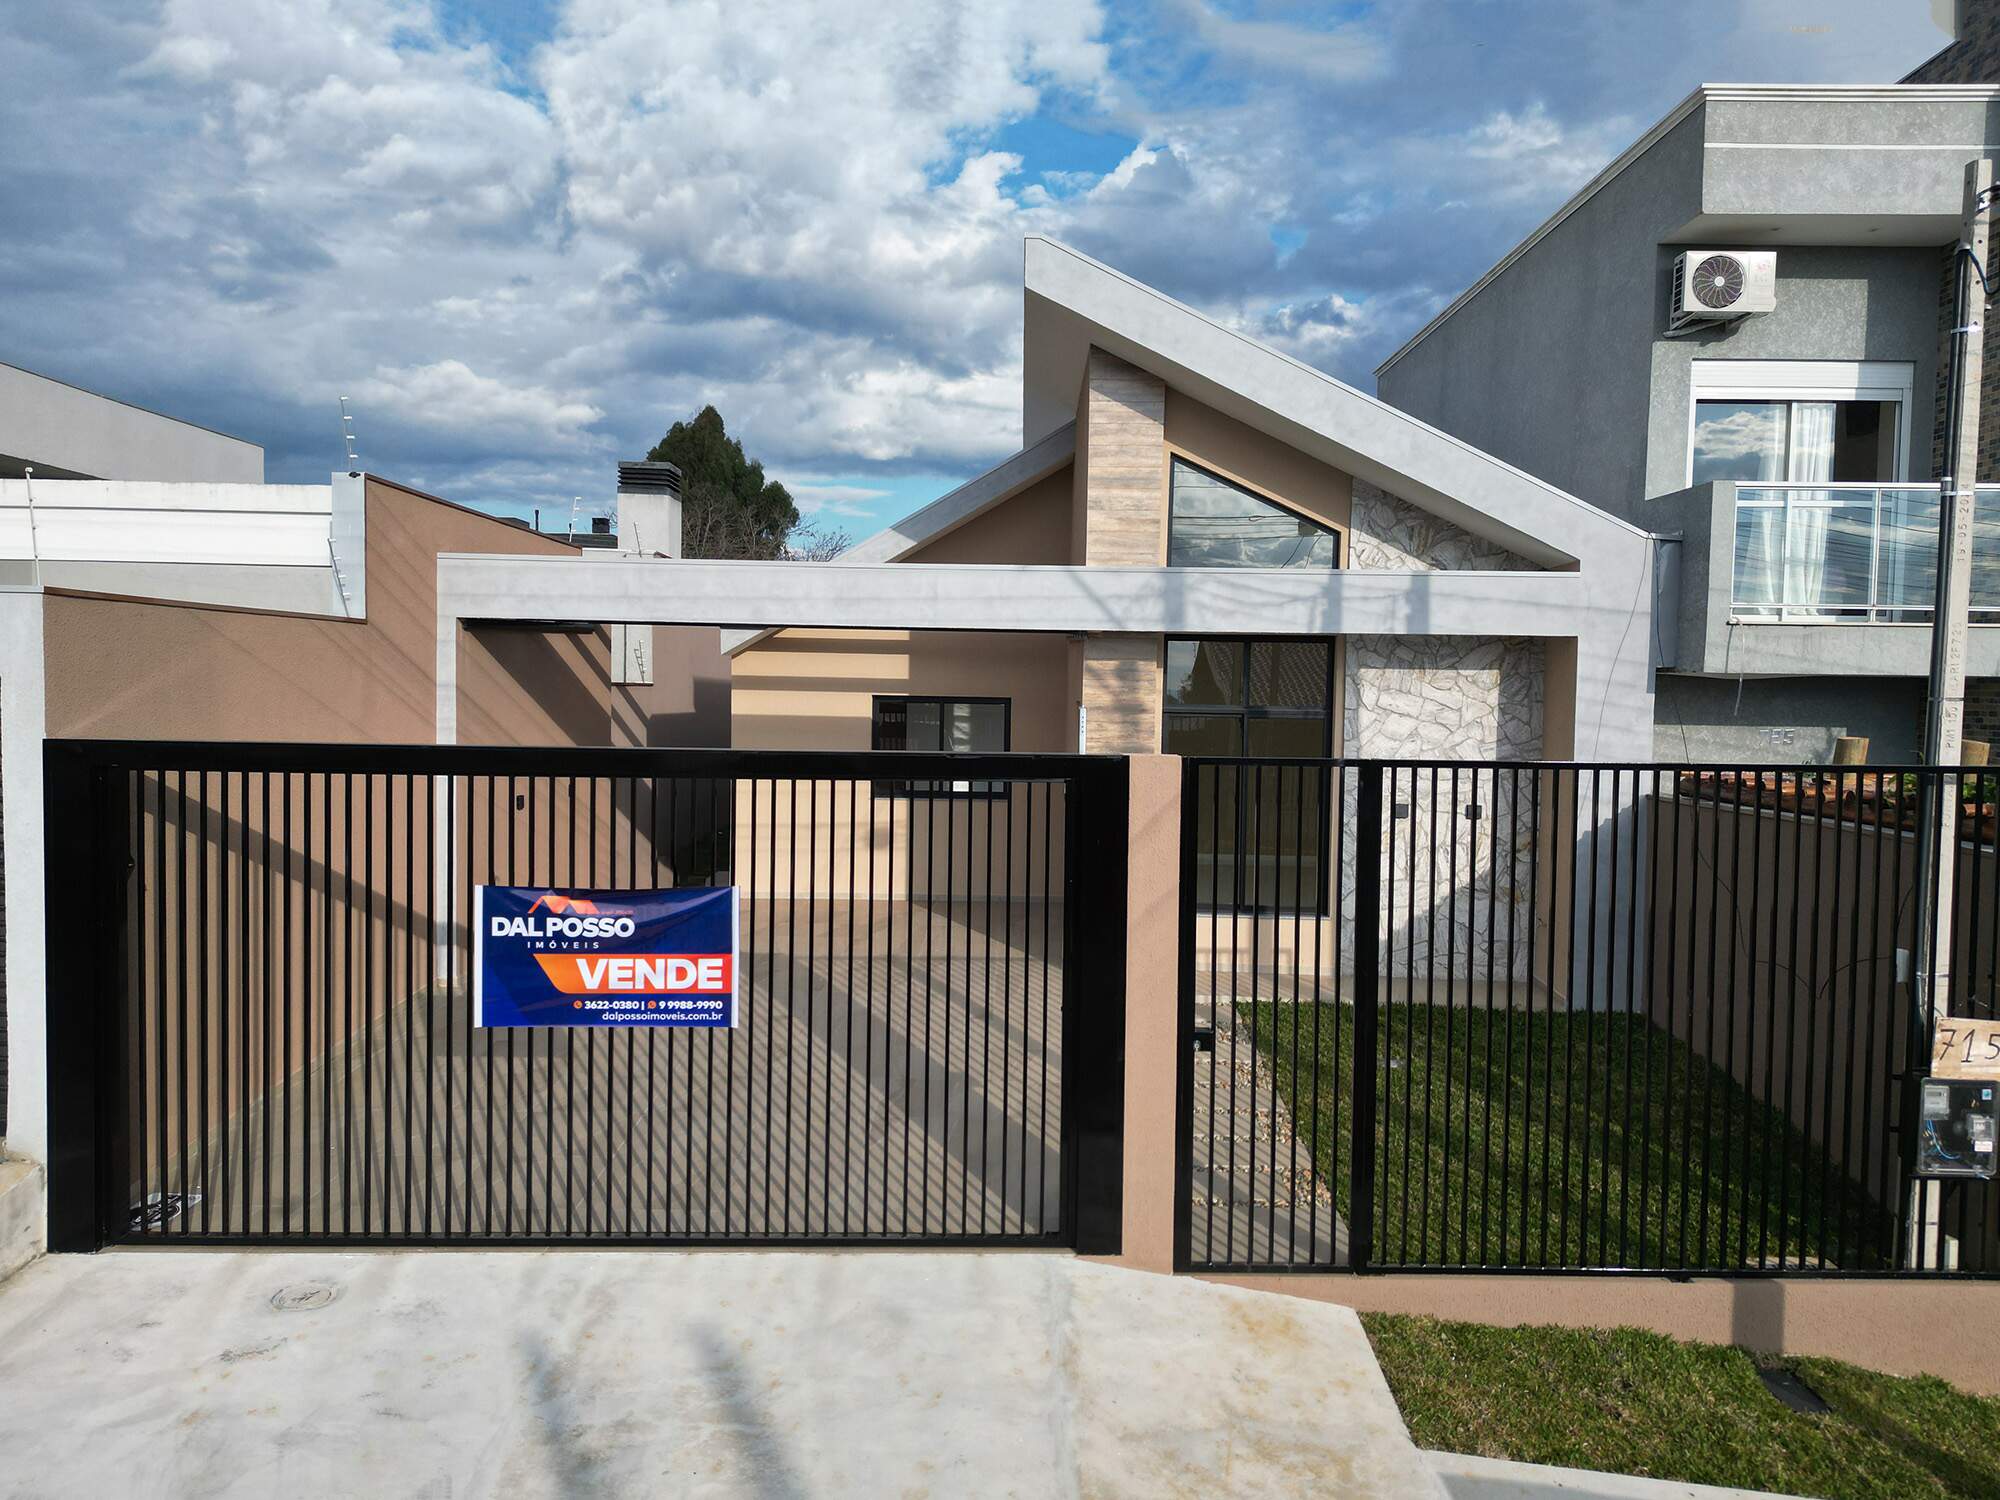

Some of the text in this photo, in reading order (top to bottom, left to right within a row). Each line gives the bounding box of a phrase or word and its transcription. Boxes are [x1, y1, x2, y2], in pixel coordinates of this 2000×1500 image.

[491, 917, 635, 938] DAL POSSO
[528, 939, 600, 949] IMÓVEIS
[576, 958, 723, 990] VENDE
[584, 1000, 640, 1010] 3622-0380
[602, 1011, 723, 1021] dalpossoimoveis.com.br
[1939, 1028, 2000, 1063] 715
